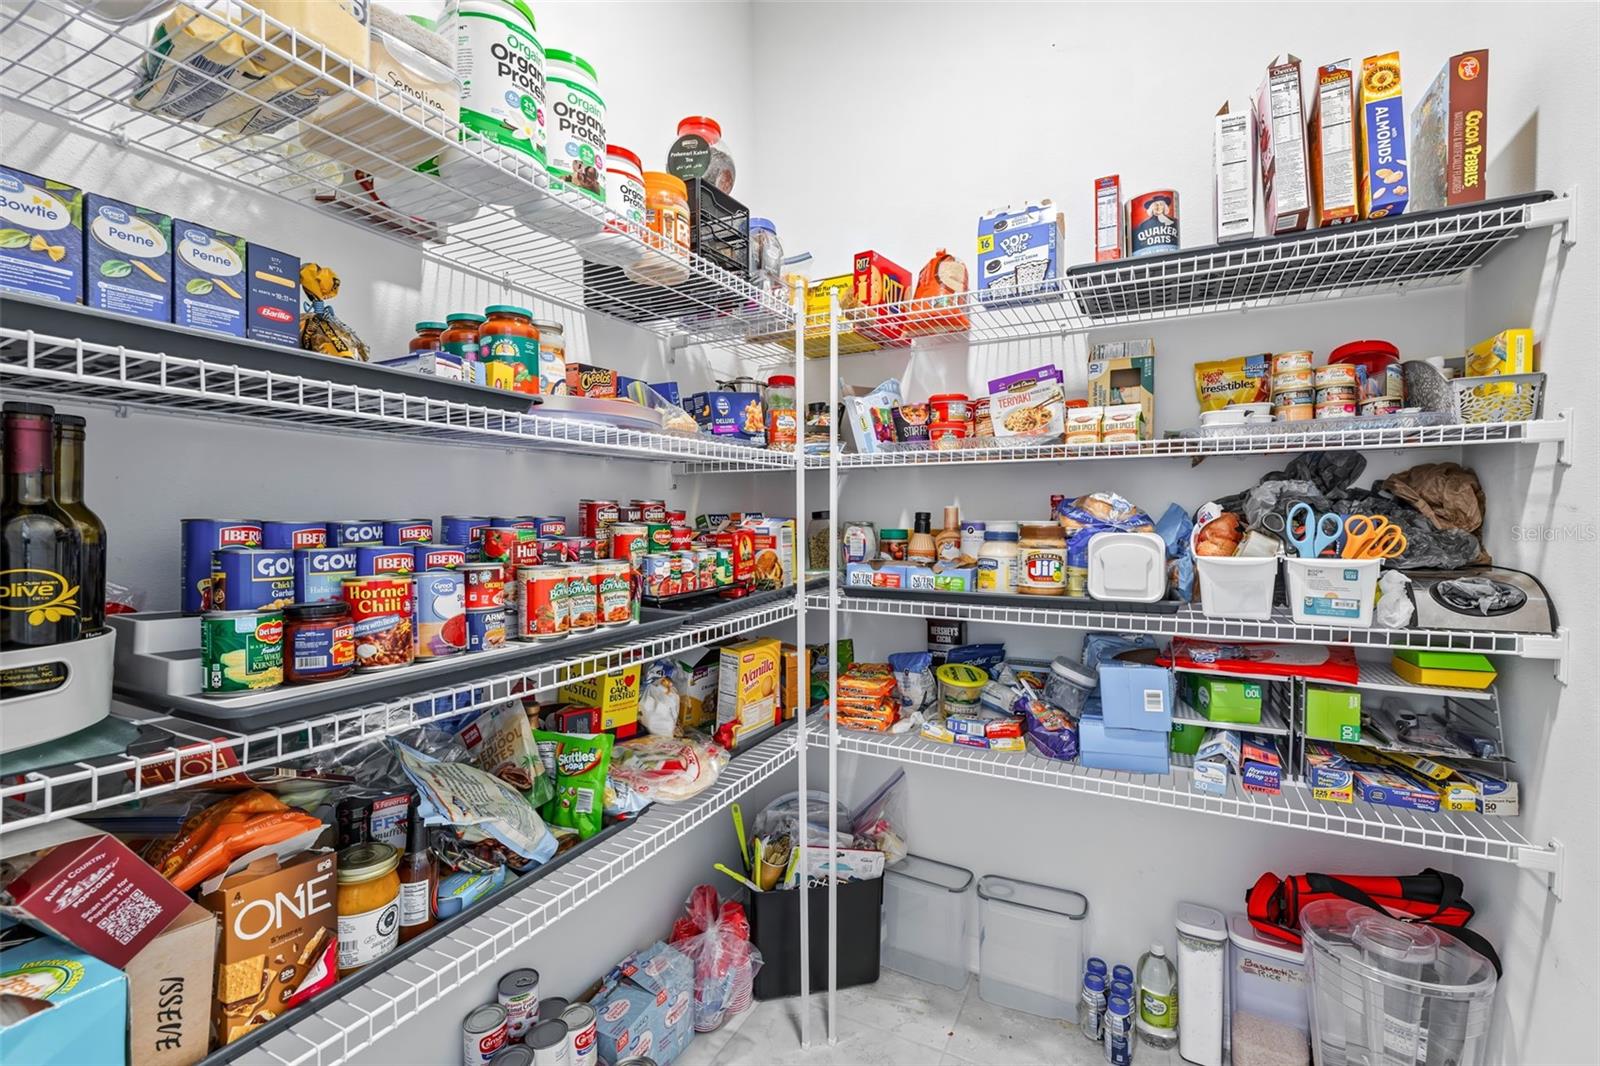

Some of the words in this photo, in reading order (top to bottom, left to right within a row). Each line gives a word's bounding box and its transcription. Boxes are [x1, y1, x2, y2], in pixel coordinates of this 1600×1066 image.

[1273, 66, 1297, 76] Cheerios
[1321, 73, 1349, 85] Cheerios
[385, 70, 446, 112] Semolina
[567, 92, 603, 119] Orgain
[1465, 110, 1483, 145] COCOA
[1375, 106, 1392, 165] ALMONDS
[1464, 145, 1482, 187] PEBBLES
[109, 226, 155, 248] Penne
[1137, 225, 1178, 242] QUAKER
[1146, 235, 1172, 246] OATS
[981, 240, 990, 249] 16
[192, 248, 232, 267] Penne
[856, 258, 871, 270] RITZ
[882, 273, 905, 301] RITZ
[261, 308, 291, 321] Barilla
[1089, 364, 1099, 374] 10
[581, 370, 611, 389] Cheetos
[1200, 380, 1256, 394] Irresistibles
[997, 393, 1031, 408] TERIYAKI
[429, 555, 464, 565] IBERIA
[1034, 560, 1060, 576] Jif
[0, 582, 54, 597] olive
[350, 583, 408, 599] Hormel
[358, 598, 401, 613] Chili
[930, 626, 959, 636] HERSHEY'S
[741, 658, 775, 686] Vanilla
[609, 690, 637, 702] BUSTELO
[1341, 726, 1353, 741] 100
[483, 745, 515, 771] DATES
[558, 752, 596, 765] Skittles
[1246, 772, 1264, 781] Wrap
[1248, 766, 1278, 777] Reynolds
[1264, 776, 1279, 784] 225
[44, 879, 68, 902] AMISH
[67, 851, 106, 879] COUNTRY
[72, 872, 115, 908] POPCORN
[234, 891, 242, 900] 4
[80, 900, 101, 919] Scan
[100, 885, 119, 903] here
[118, 877, 129, 889] for
[87, 894, 119, 924] Popping
[118, 881, 135, 897] Tips
[234, 874, 335, 940] ONE
[1243, 959, 1288, 976] Basmati
[1257, 970, 1281, 982] Rice
